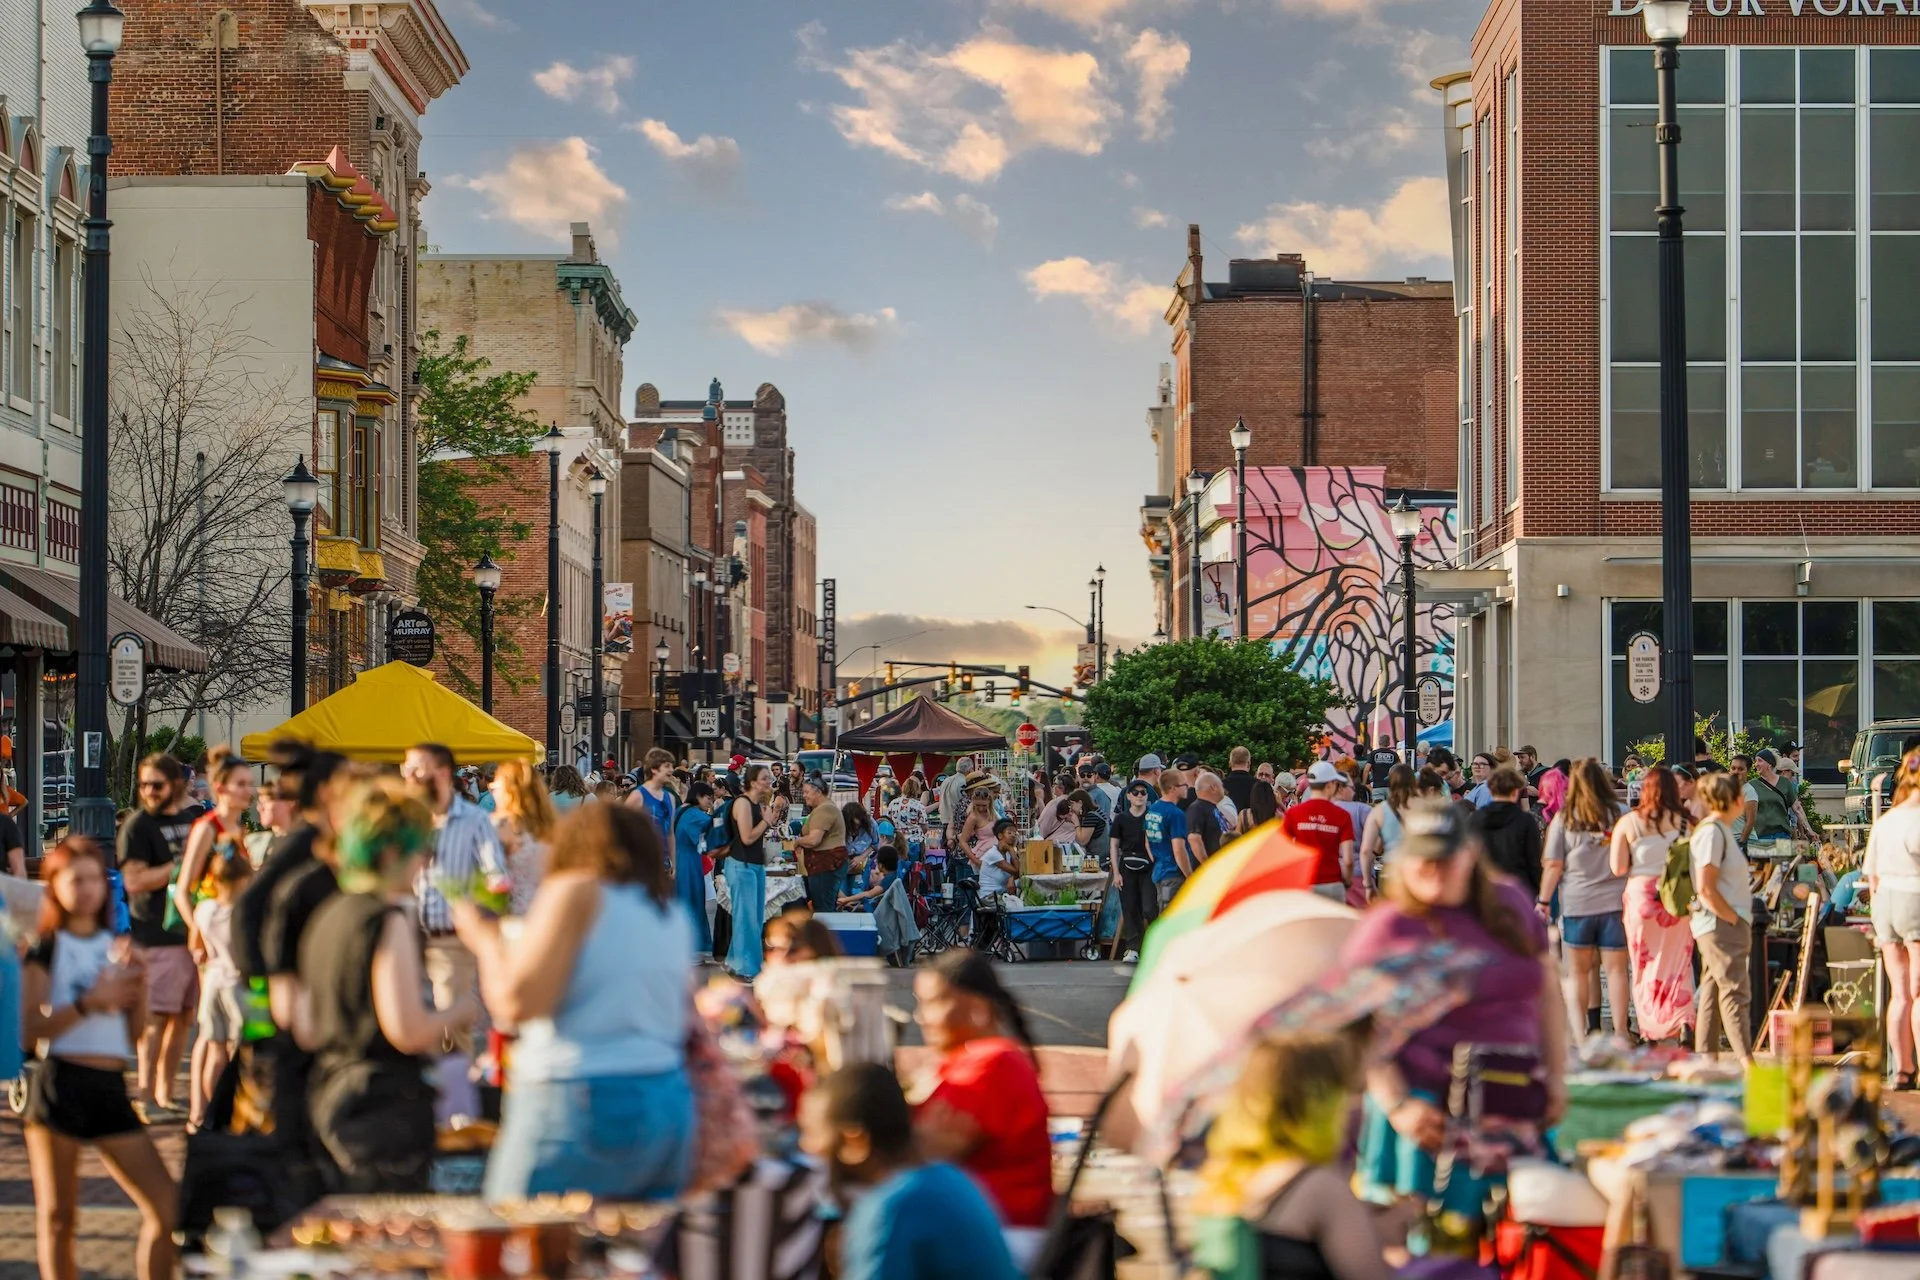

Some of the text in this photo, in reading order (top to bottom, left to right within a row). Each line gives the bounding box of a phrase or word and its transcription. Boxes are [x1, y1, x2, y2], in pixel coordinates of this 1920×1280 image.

[397, 620, 416, 628] ART
[824, 580, 833, 661] accutech
[1019, 730, 1037, 738] STOP
